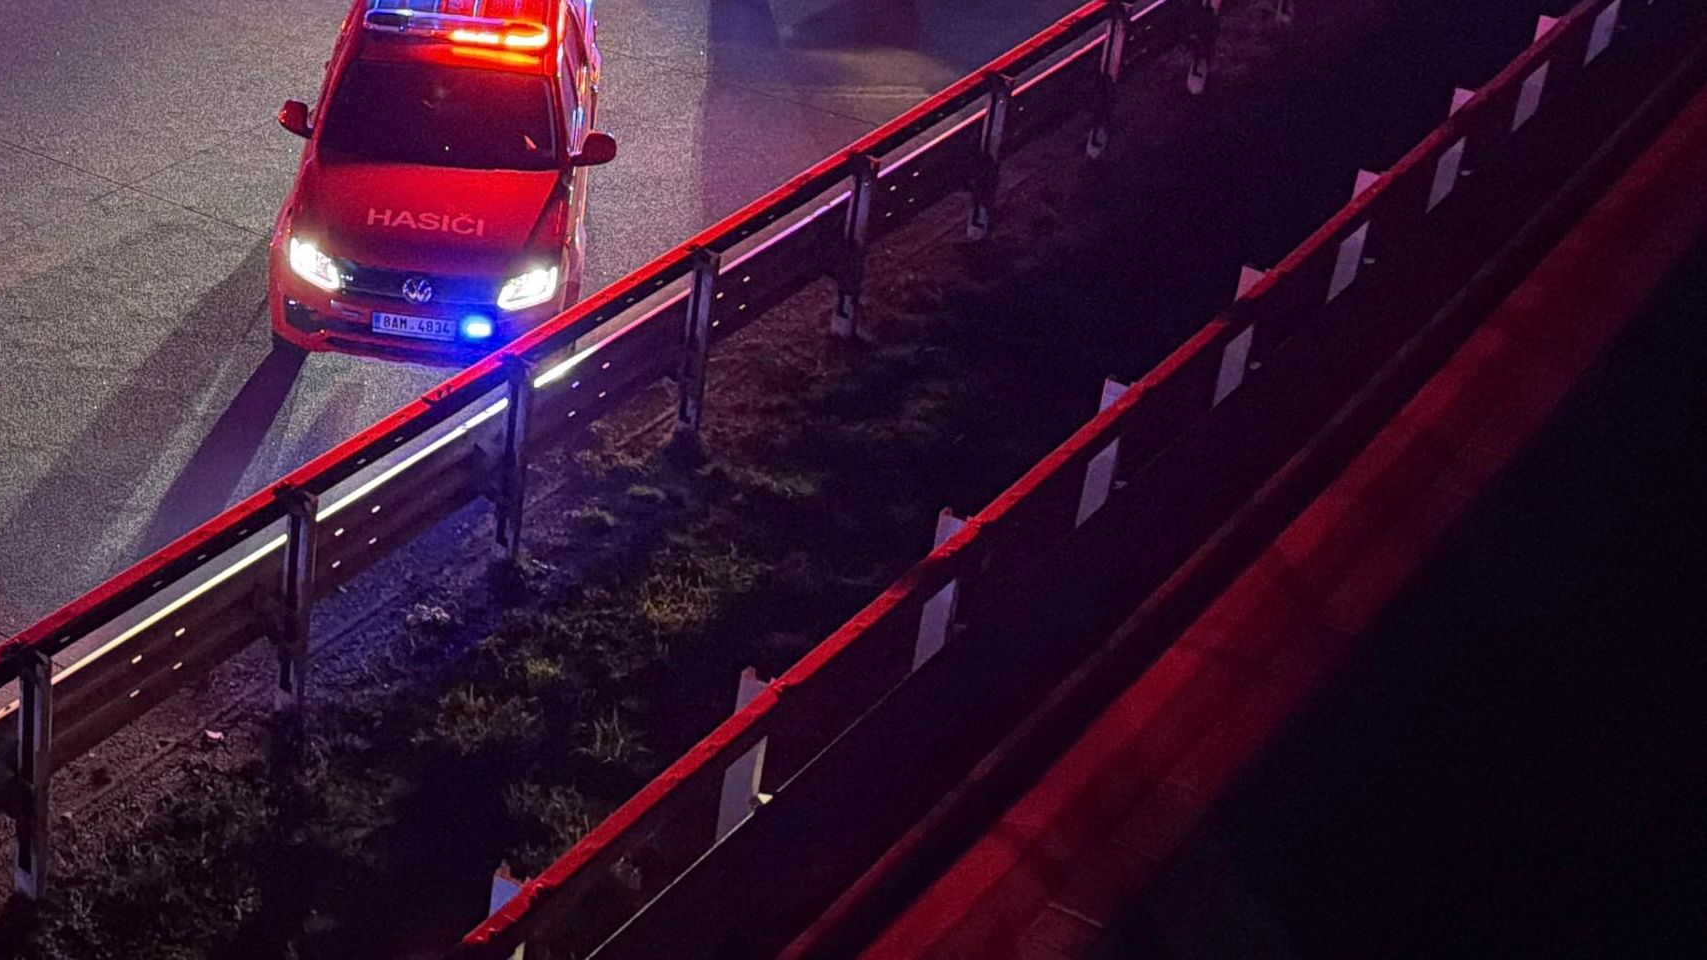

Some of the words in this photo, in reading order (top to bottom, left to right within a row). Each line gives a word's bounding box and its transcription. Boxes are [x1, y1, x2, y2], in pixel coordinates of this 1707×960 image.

[366, 208, 485, 236] HASIČI
[383, 315, 408, 330] 8AM
[417, 320, 451, 335] 4834
